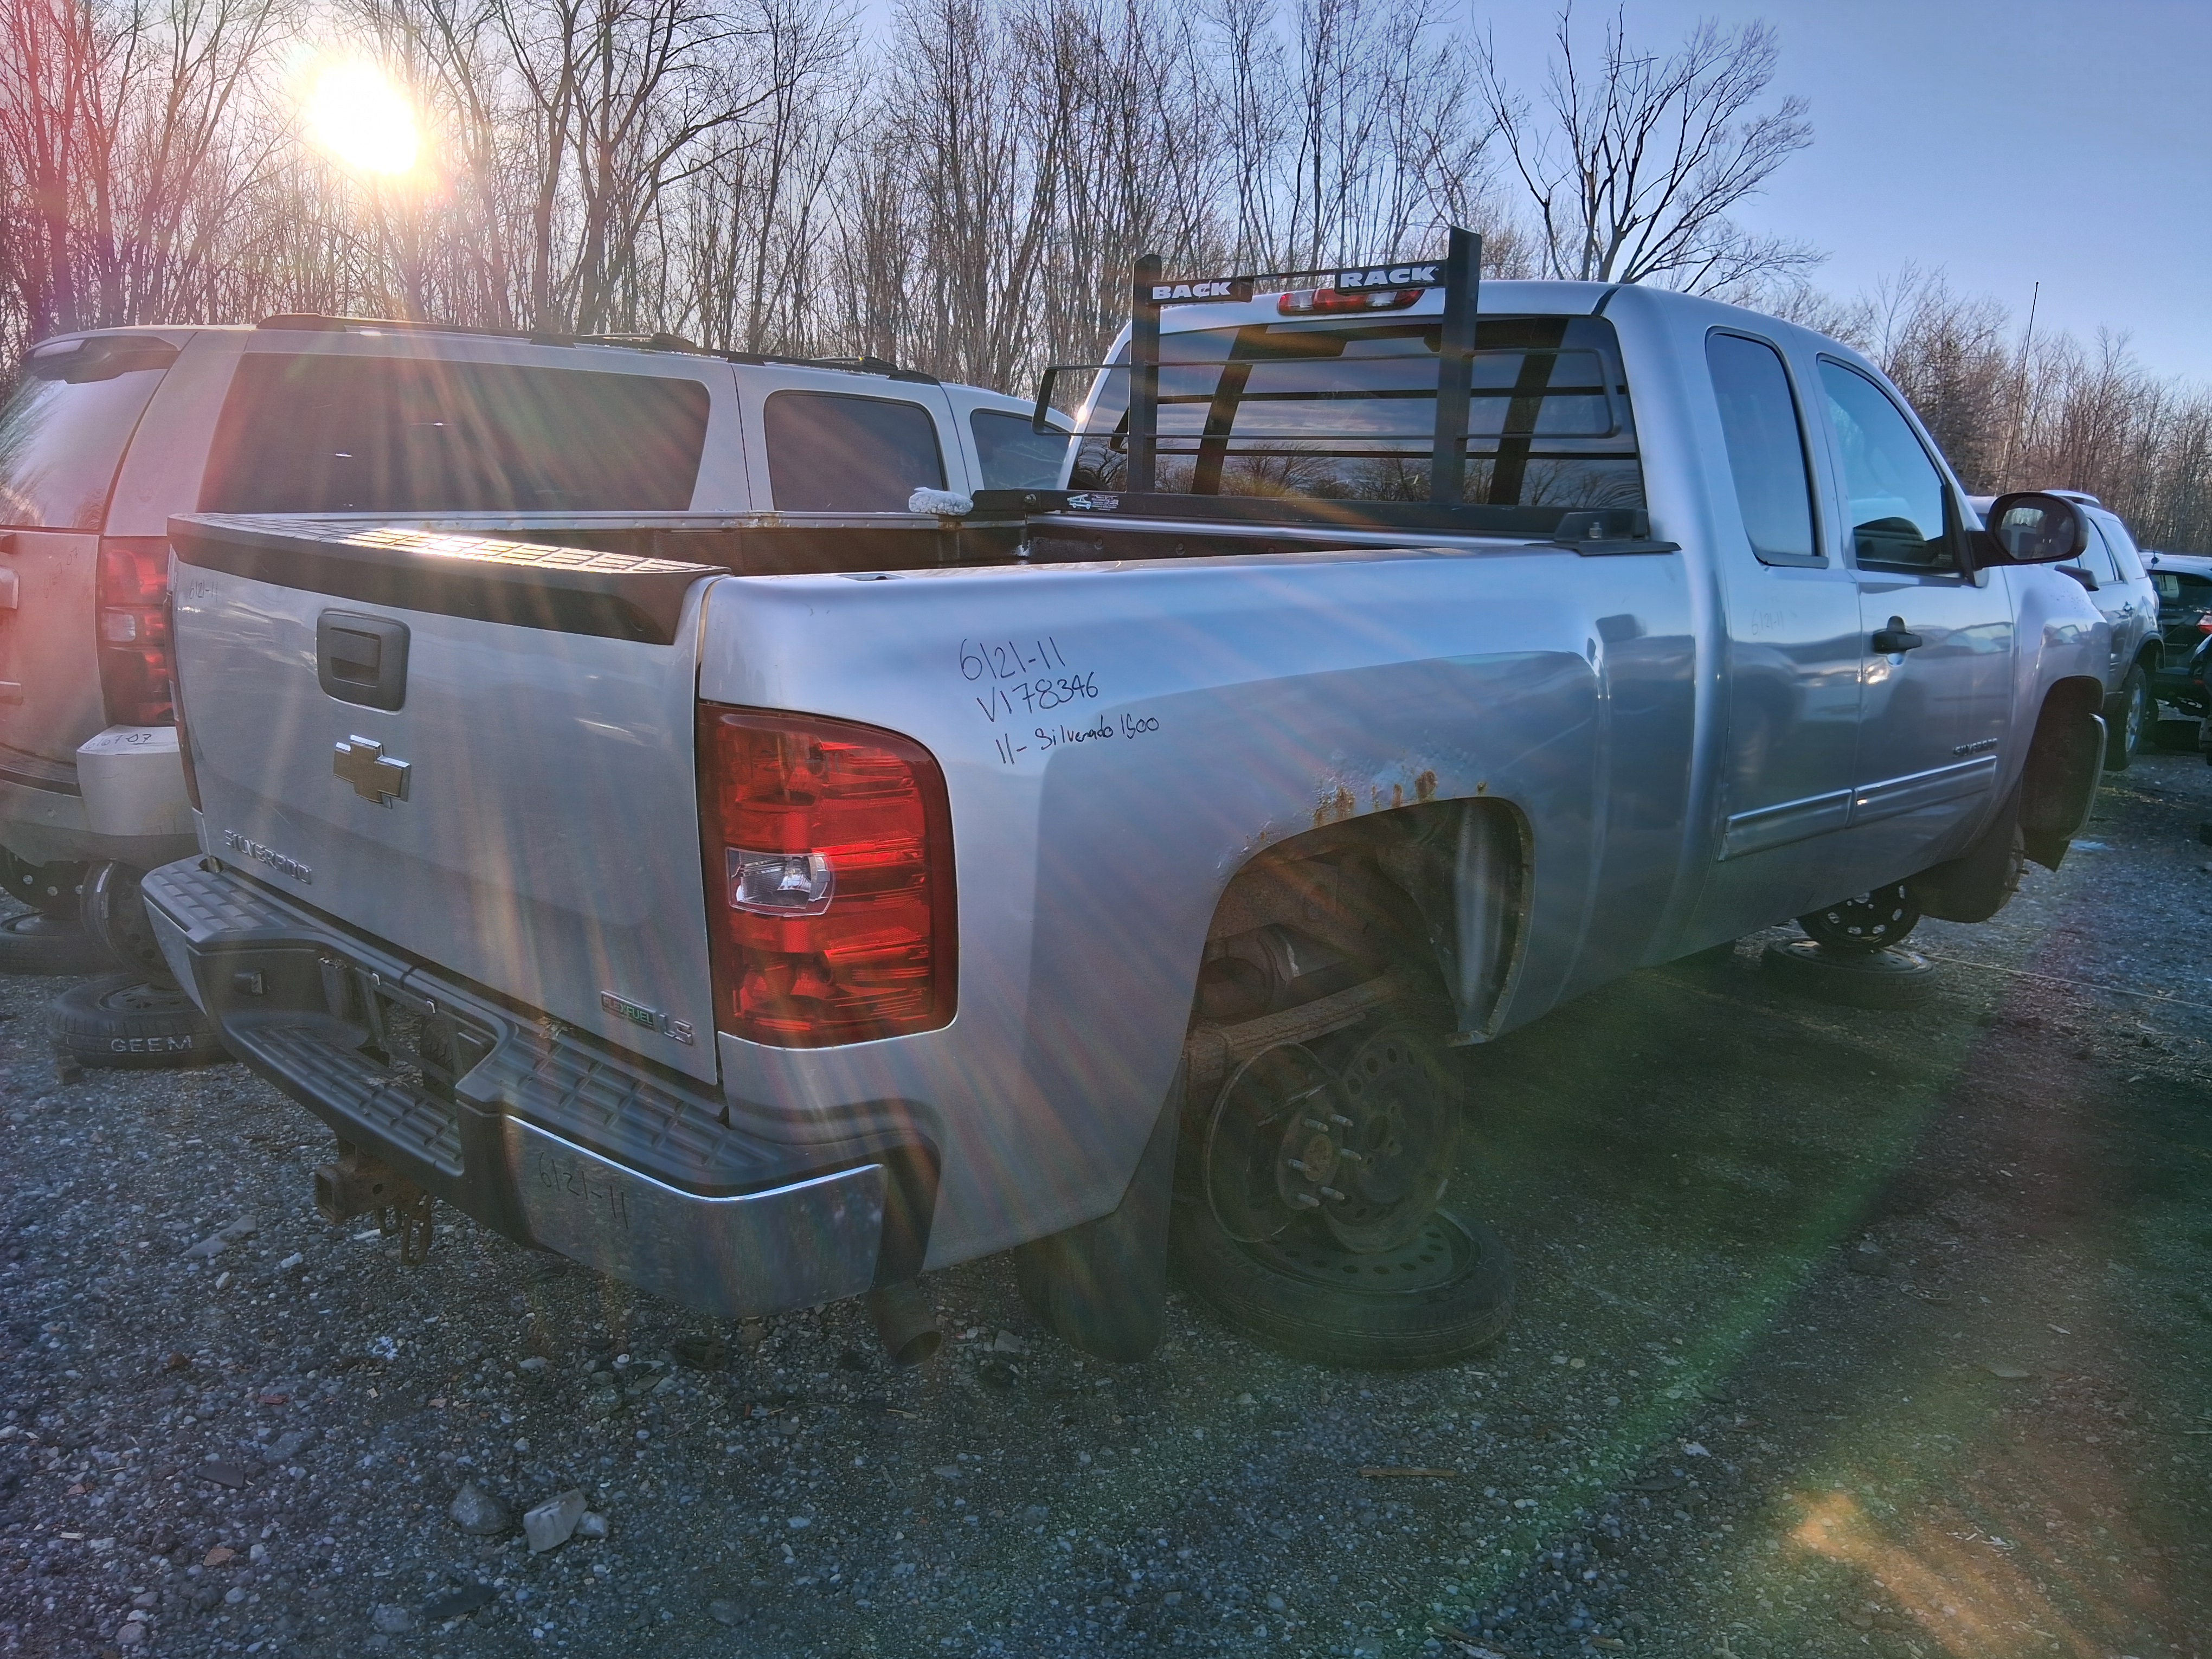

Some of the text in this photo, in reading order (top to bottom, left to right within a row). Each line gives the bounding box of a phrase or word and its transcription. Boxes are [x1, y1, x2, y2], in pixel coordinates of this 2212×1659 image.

[1153, 266, 1437, 299] BACK RACK
[1752, 609, 1784, 635] 6121-11
[960, 636, 1065, 680] 6121-11
[976, 671, 1098, 722] V178346
[1035, 715, 1113, 750] Silverado
[1120, 713, 1159, 739] 1500
[224, 829, 312, 885] SILVERADO
[111, 1035, 192, 1052] GEEM
[539, 1152, 628, 1230] 6121-11
